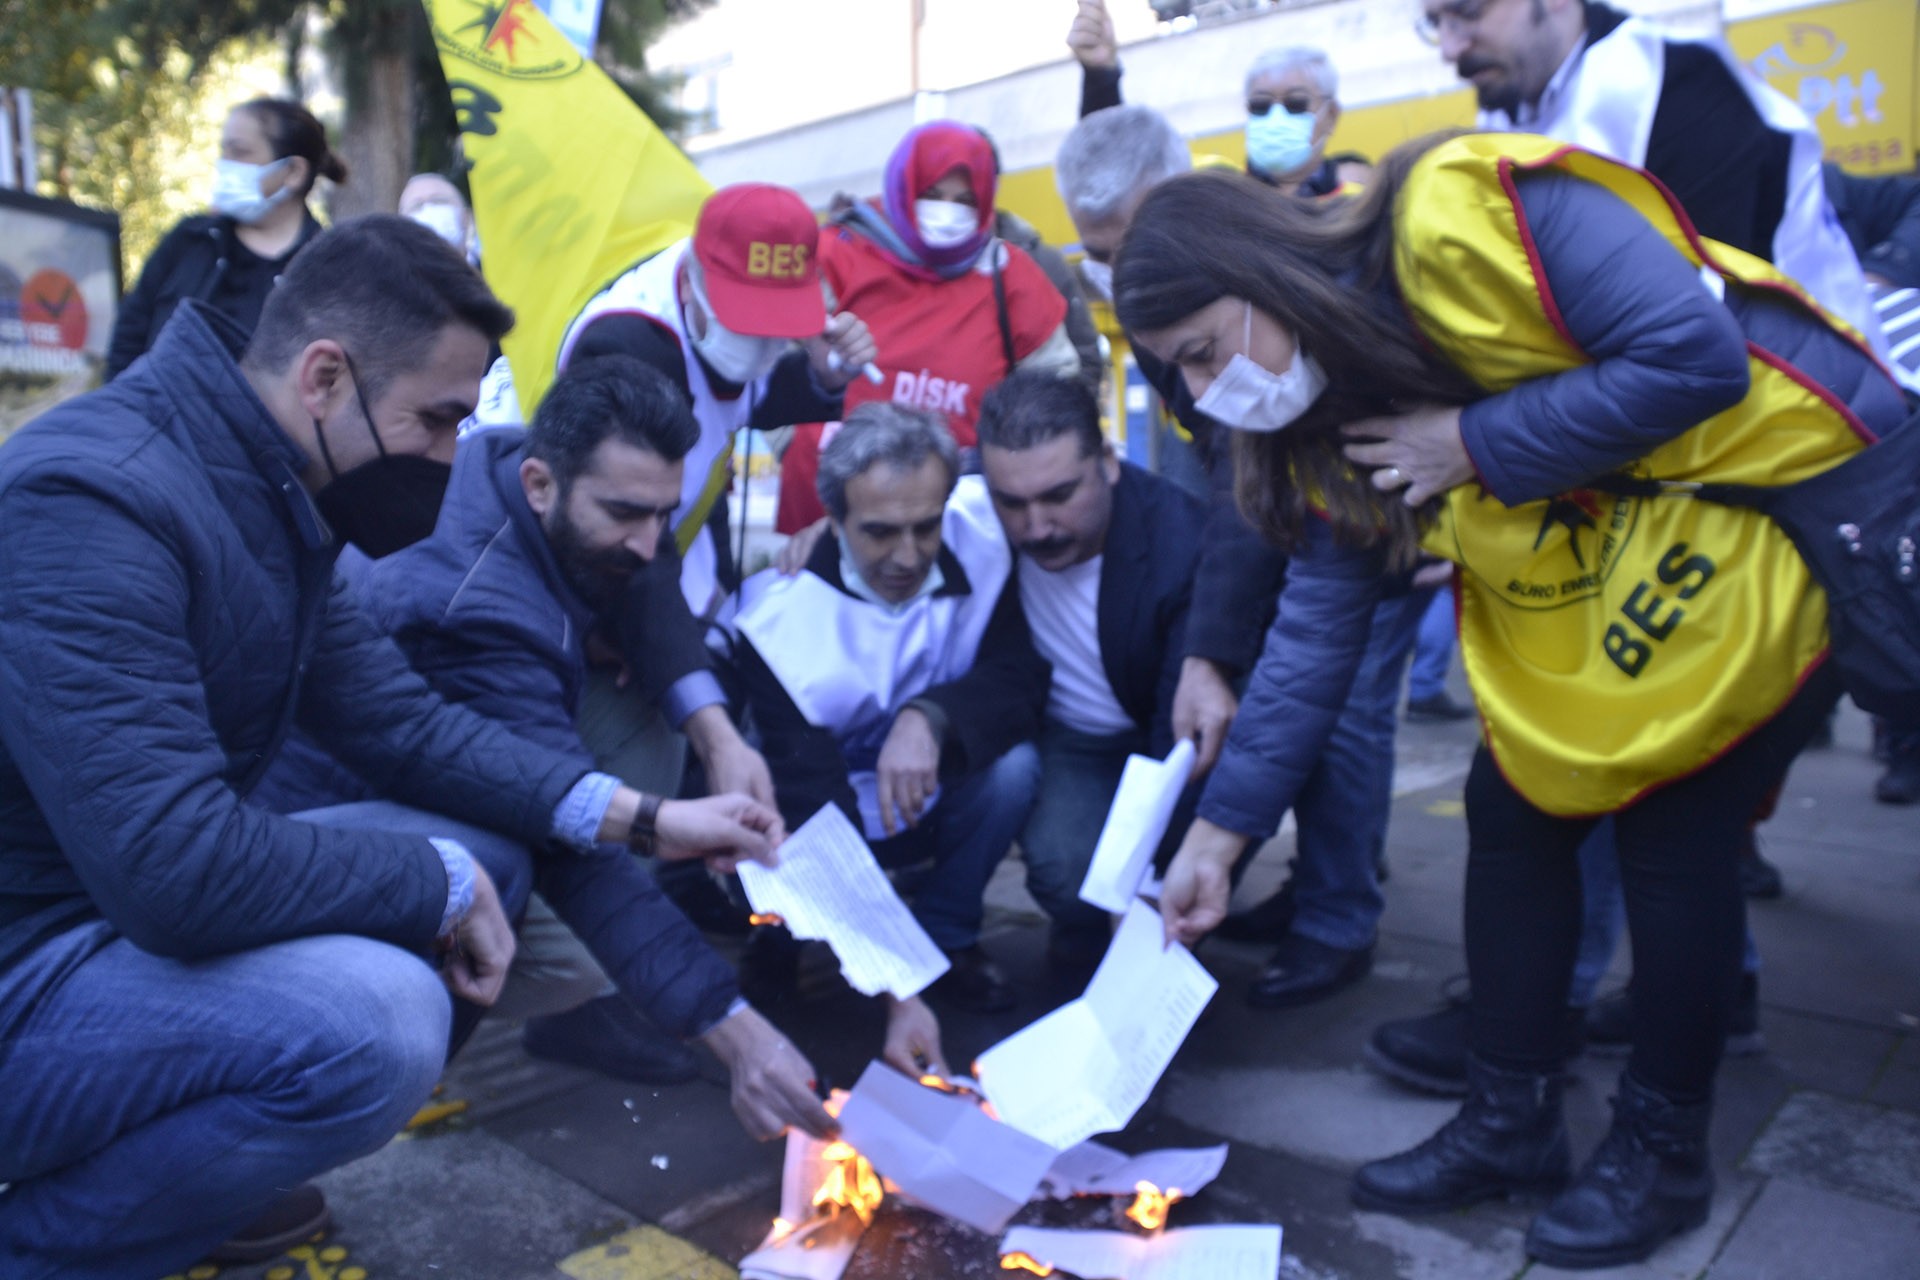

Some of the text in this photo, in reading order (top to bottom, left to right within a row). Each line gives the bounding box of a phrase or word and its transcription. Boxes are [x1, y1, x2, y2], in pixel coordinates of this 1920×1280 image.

[747, 240, 809, 278] BES
[892, 368, 970, 417] DİSK
[1602, 541, 1716, 679] BES
